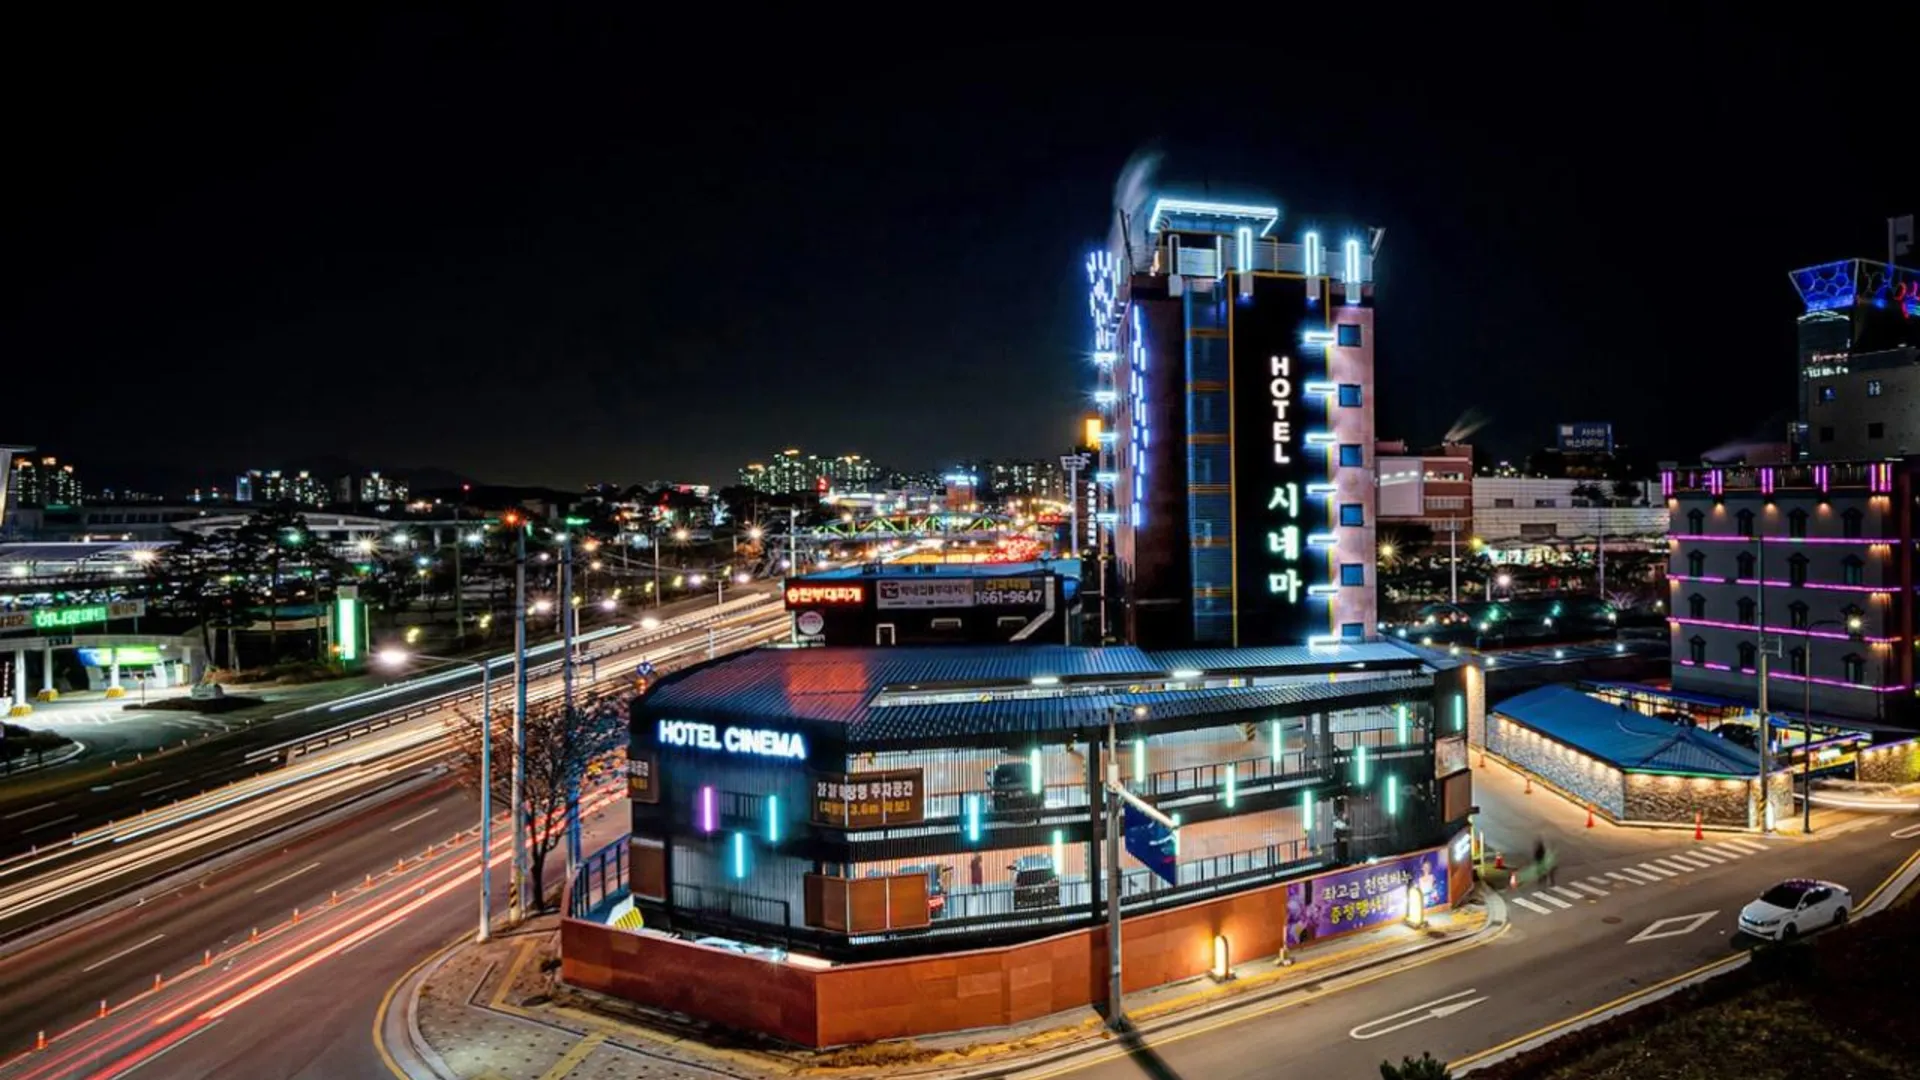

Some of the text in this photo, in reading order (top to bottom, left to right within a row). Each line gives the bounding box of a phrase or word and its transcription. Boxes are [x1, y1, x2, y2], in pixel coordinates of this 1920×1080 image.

[1267, 356, 1303, 604] HOTEL 시네마
[975, 590, 1042, 604] 1661-9647
[659, 719, 806, 759] HOTEL CINEMA
